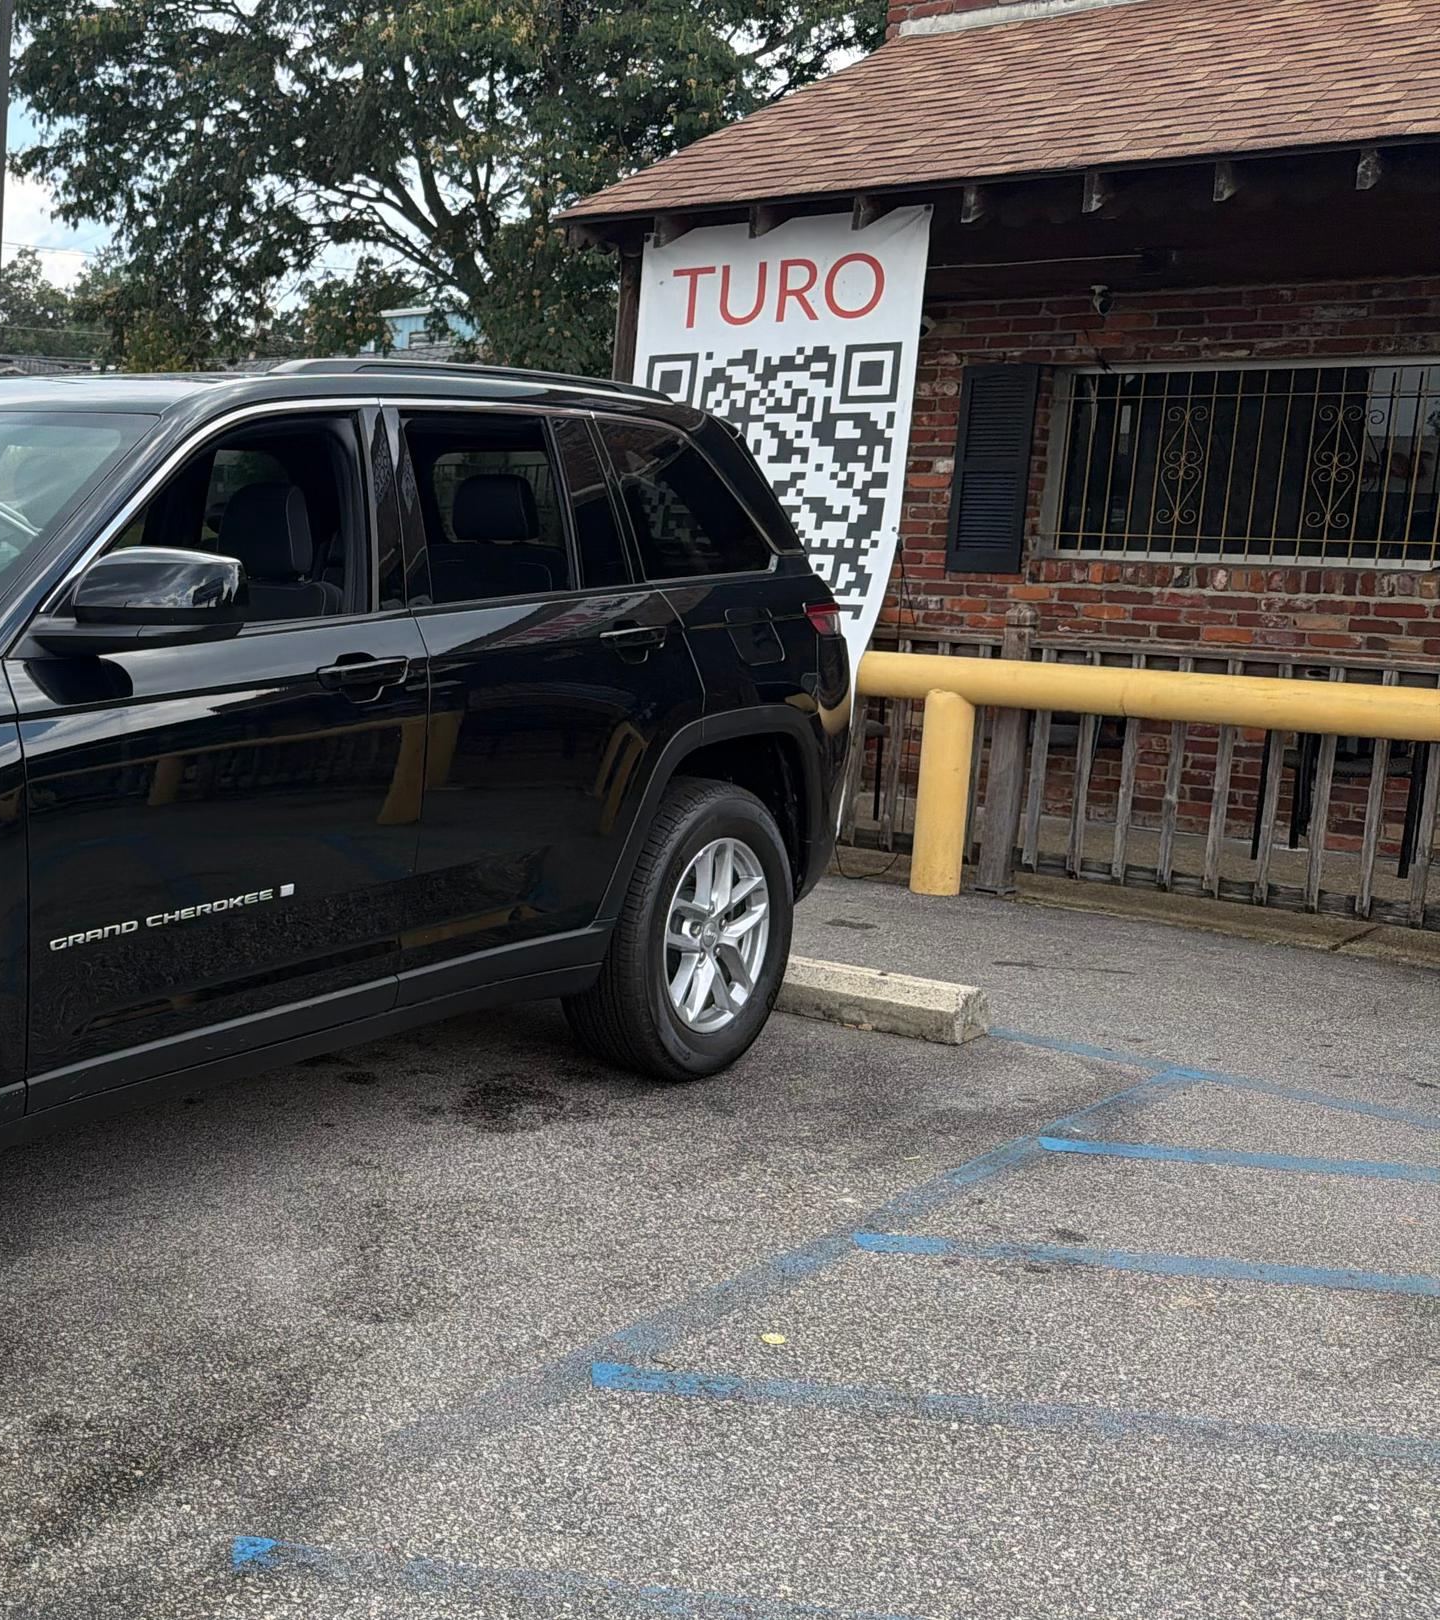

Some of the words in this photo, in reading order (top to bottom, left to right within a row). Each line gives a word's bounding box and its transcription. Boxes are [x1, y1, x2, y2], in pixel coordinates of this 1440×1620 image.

[672, 252, 885, 329] TURO
[49, 920, 139, 951] GRAND
[145, 888, 274, 928] CHEROKEE
